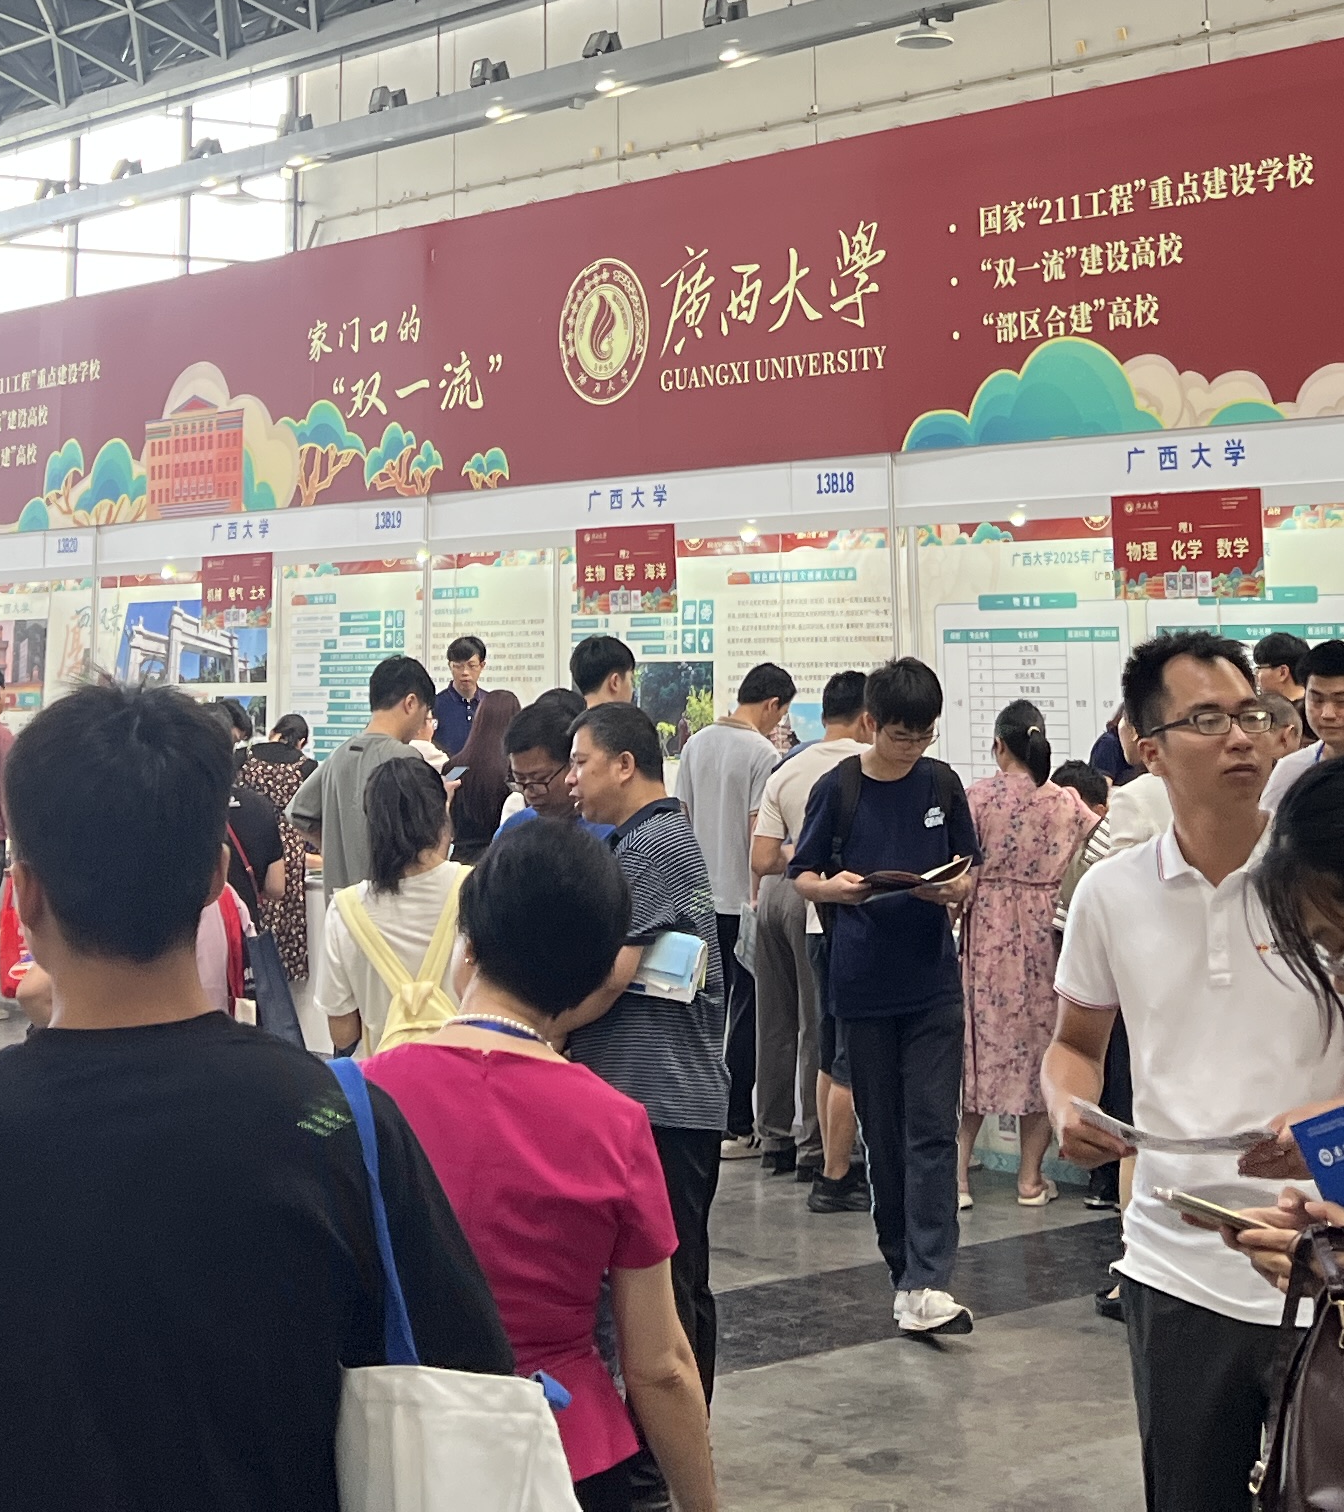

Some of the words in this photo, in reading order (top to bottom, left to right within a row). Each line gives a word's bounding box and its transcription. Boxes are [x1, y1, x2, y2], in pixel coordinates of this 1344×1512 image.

[978, 152, 1315, 237] 国家“211工程”重点建设学校
[980, 232, 1184, 289] “双一流”建设高校
[307, 304, 421, 363] 家门口的
[982, 293, 1160, 344] “部区合建”高校
[332, 350, 503, 419] “双一流”
[660, 360, 750, 392] GUANGXI
[755, 345, 888, 383] UNIVERSITY
[1126, 438, 1246, 475] 广西大学
[587, 483, 668, 512] 广西大学
[816, 471, 854, 495] 13B18
[210, 518, 270, 541] 广西大学
[375, 510, 402, 530] 13B19
[1126, 541, 1159, 562] 物理
[1171, 539, 1203, 561] 化学
[1216, 538, 1250, 559] 数学
[584, 564, 606, 583] 生物
[613, 563, 636, 581] 医学
[644, 562, 667, 580] 海洋
[249, 585, 266, 601] 土木
